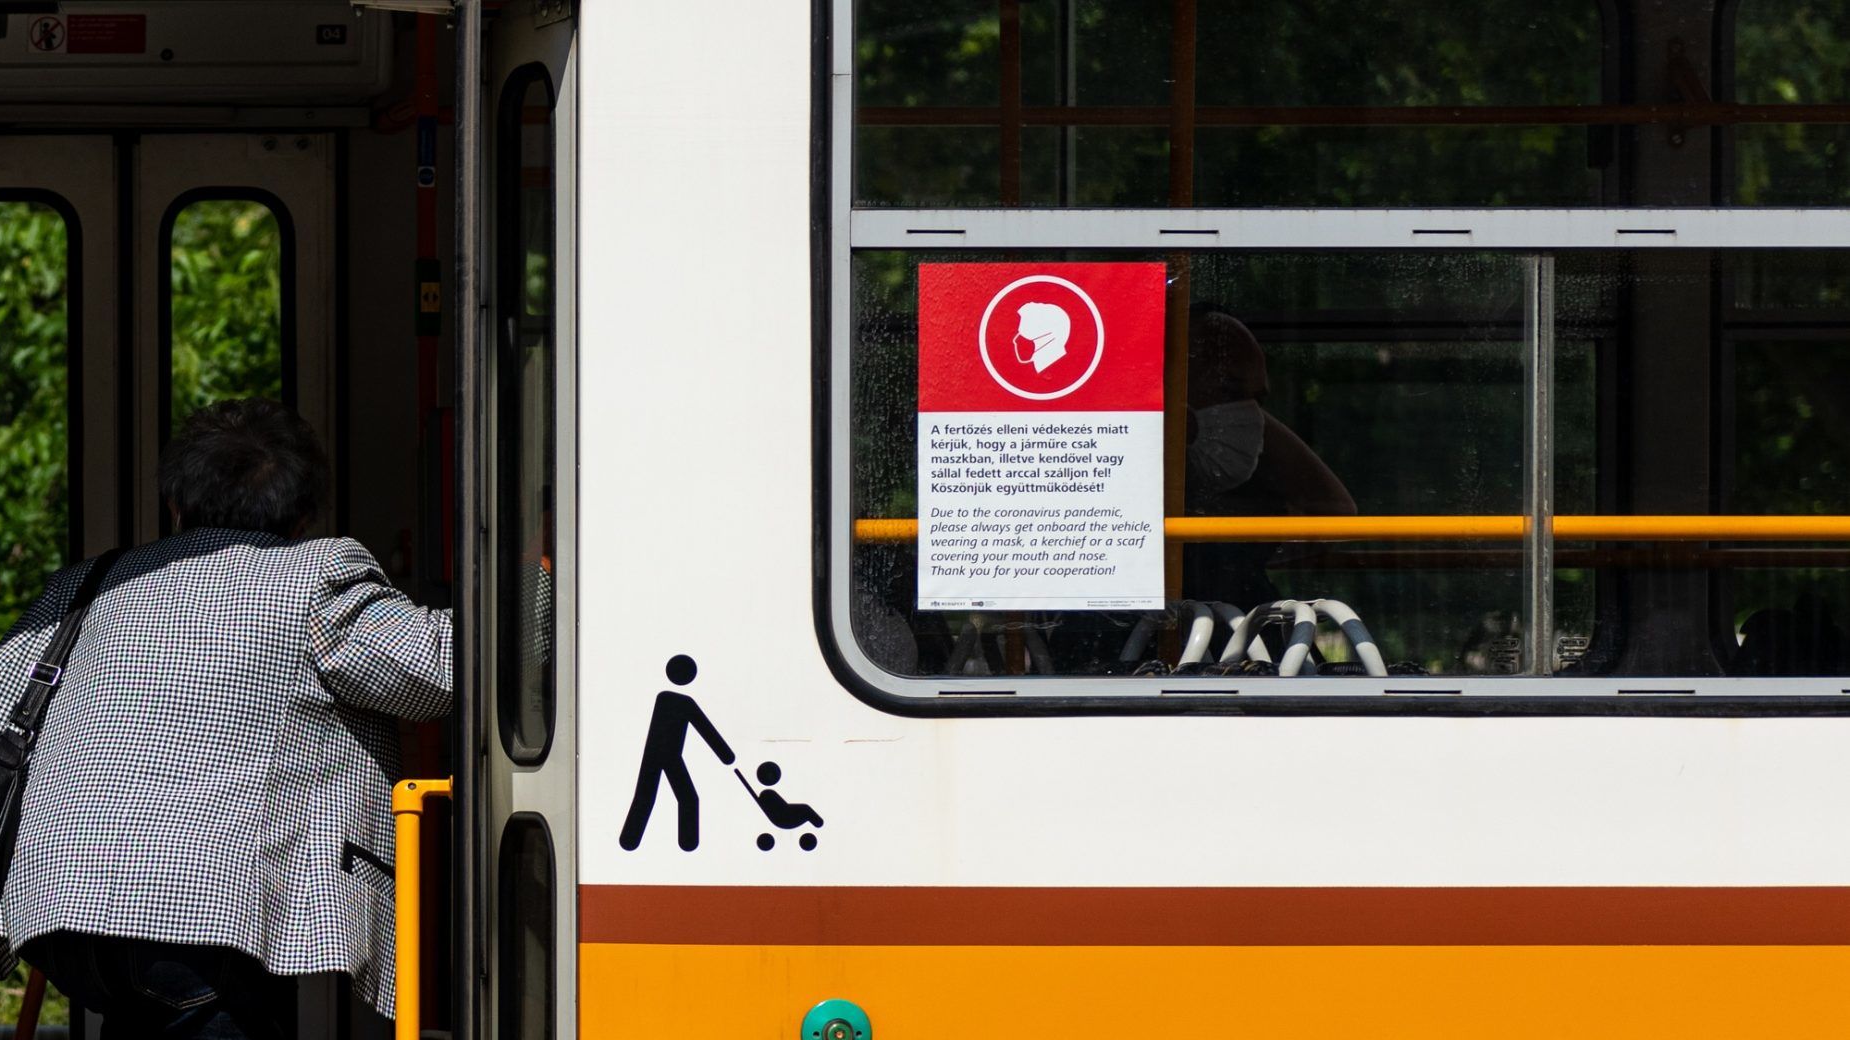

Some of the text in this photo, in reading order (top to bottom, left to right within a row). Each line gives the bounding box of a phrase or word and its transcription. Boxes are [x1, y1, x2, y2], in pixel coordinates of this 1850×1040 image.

[322, 27, 342, 40] 04
[931, 424, 1129, 435] A fertőzés elleni védekezés miatt
[931, 439, 972, 452] kérjük,
[976, 439, 1006, 452] hogy
[1020, 439, 1068, 452] járműre
[1071, 439, 1097, 449] csak
[931, 453, 1124, 466] maszkban, illetve kendővel vagy
[931, 467, 1111, 481] sállal fedett arccal szálljon fel!
[931, 482, 992, 495] Köszönjük
[930, 507, 1123, 519] Due to the coronavirus pandemic,
[930, 521, 1152, 535] please always get onboard the vehicle,
[931, 537, 978, 549] wearing
[992, 536, 1025, 547] mask,
[1041, 536, 1087, 549] kerchief
[1116, 535, 1146, 549] scarf
[930, 551, 1108, 564] covering your mouth and nose.
[931, 565, 1116, 578] Thank you for your cooperation!
